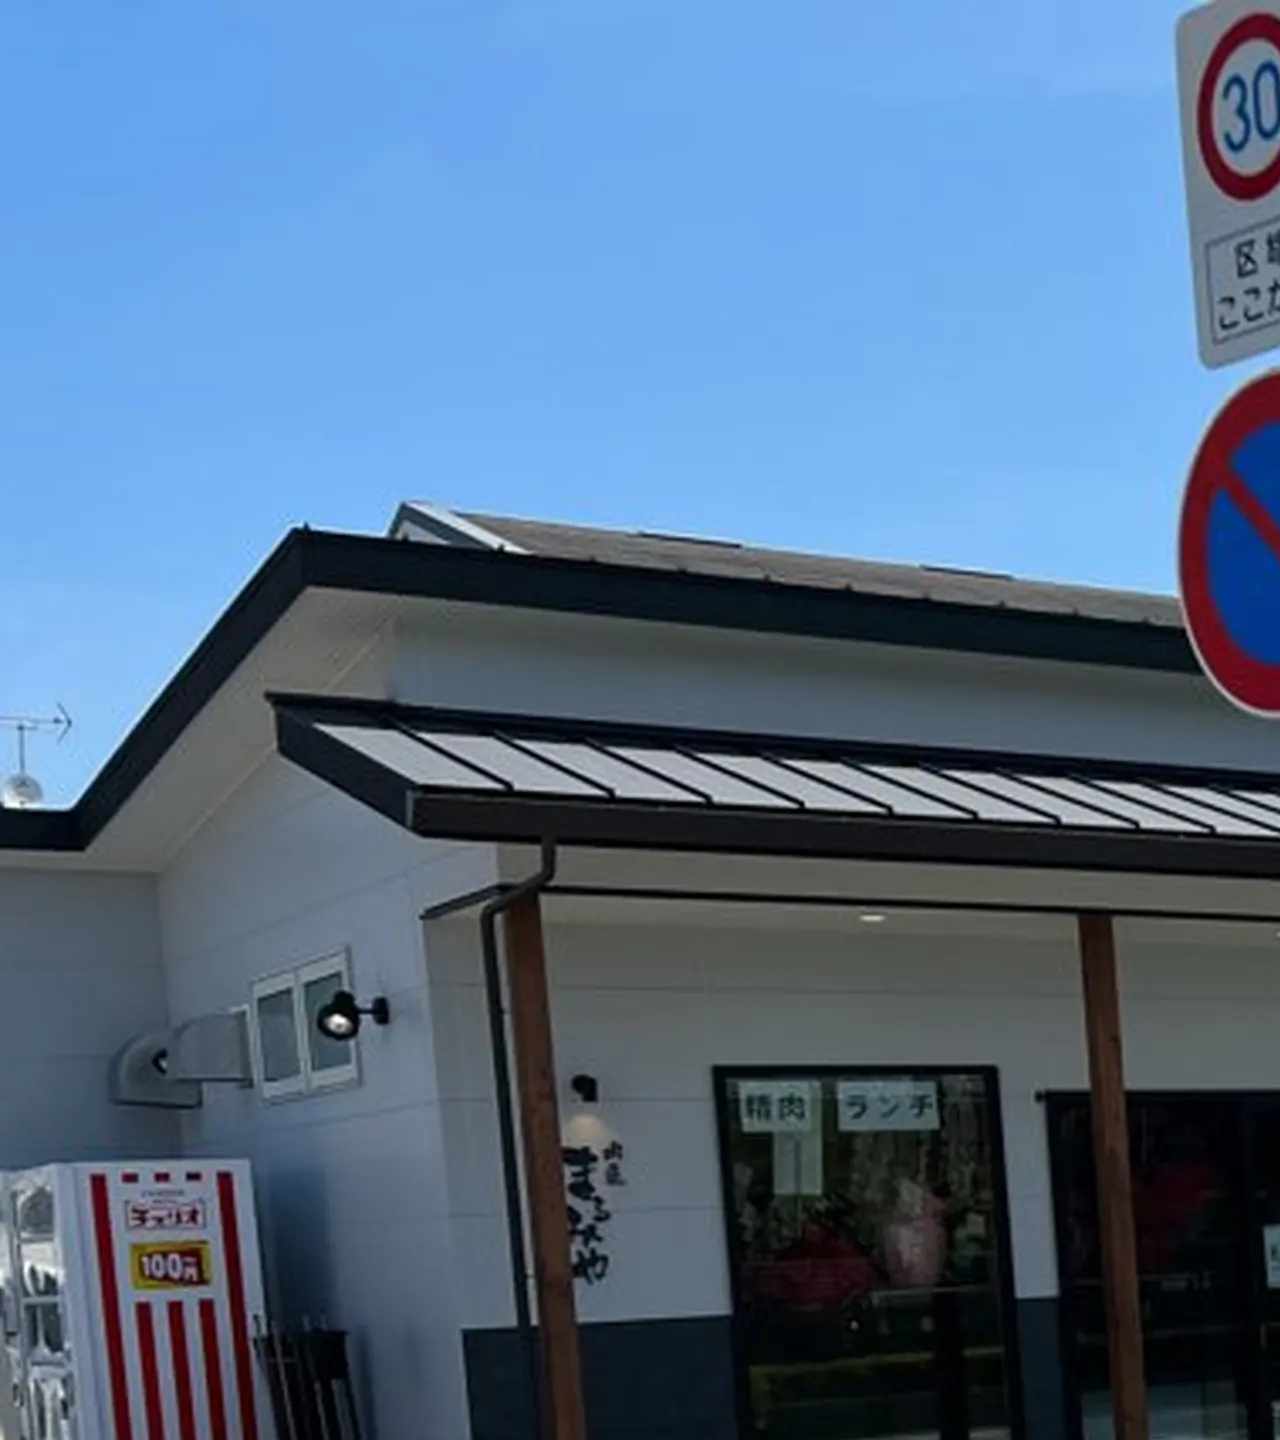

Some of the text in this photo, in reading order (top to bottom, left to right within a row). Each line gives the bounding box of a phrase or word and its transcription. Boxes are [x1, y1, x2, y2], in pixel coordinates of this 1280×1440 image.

[745, 1092, 806, 1122] 精肉
[845, 1093, 934, 1121] ランチ
[140, 1252, 199, 1282] 100円
